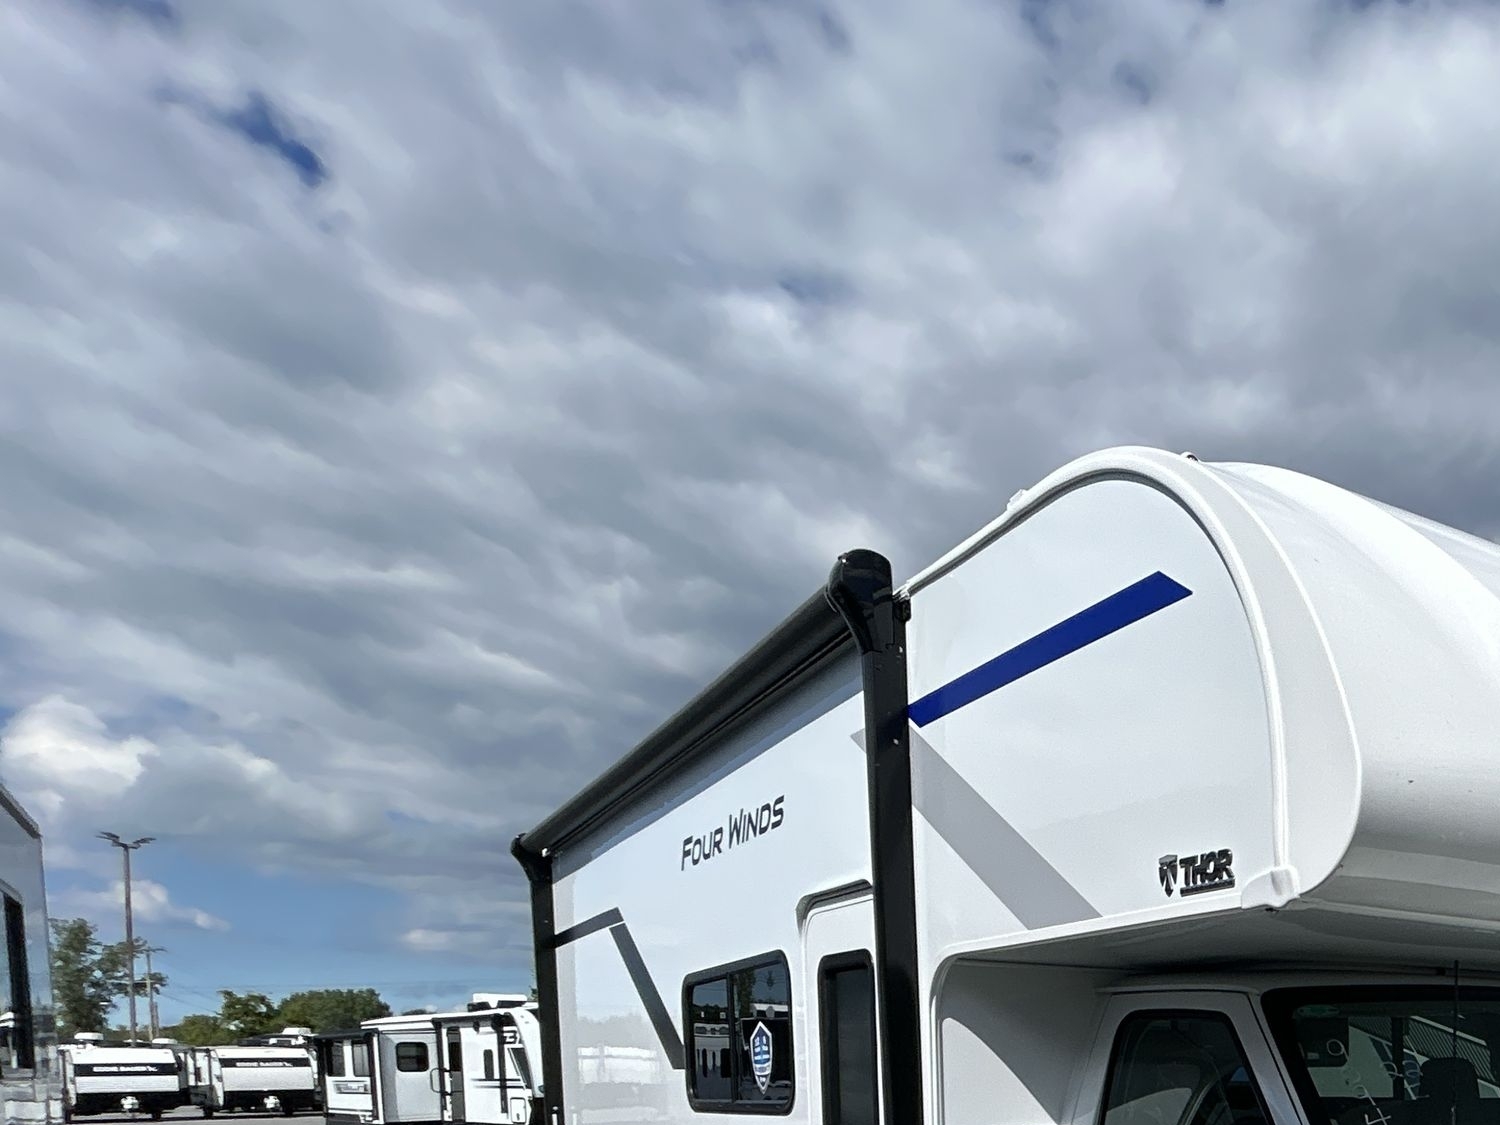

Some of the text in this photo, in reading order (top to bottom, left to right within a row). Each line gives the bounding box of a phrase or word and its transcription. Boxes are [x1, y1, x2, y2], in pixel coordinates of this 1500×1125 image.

[681, 795, 784, 871] FOUR WINDS
[1179, 848, 1235, 887] THOR
